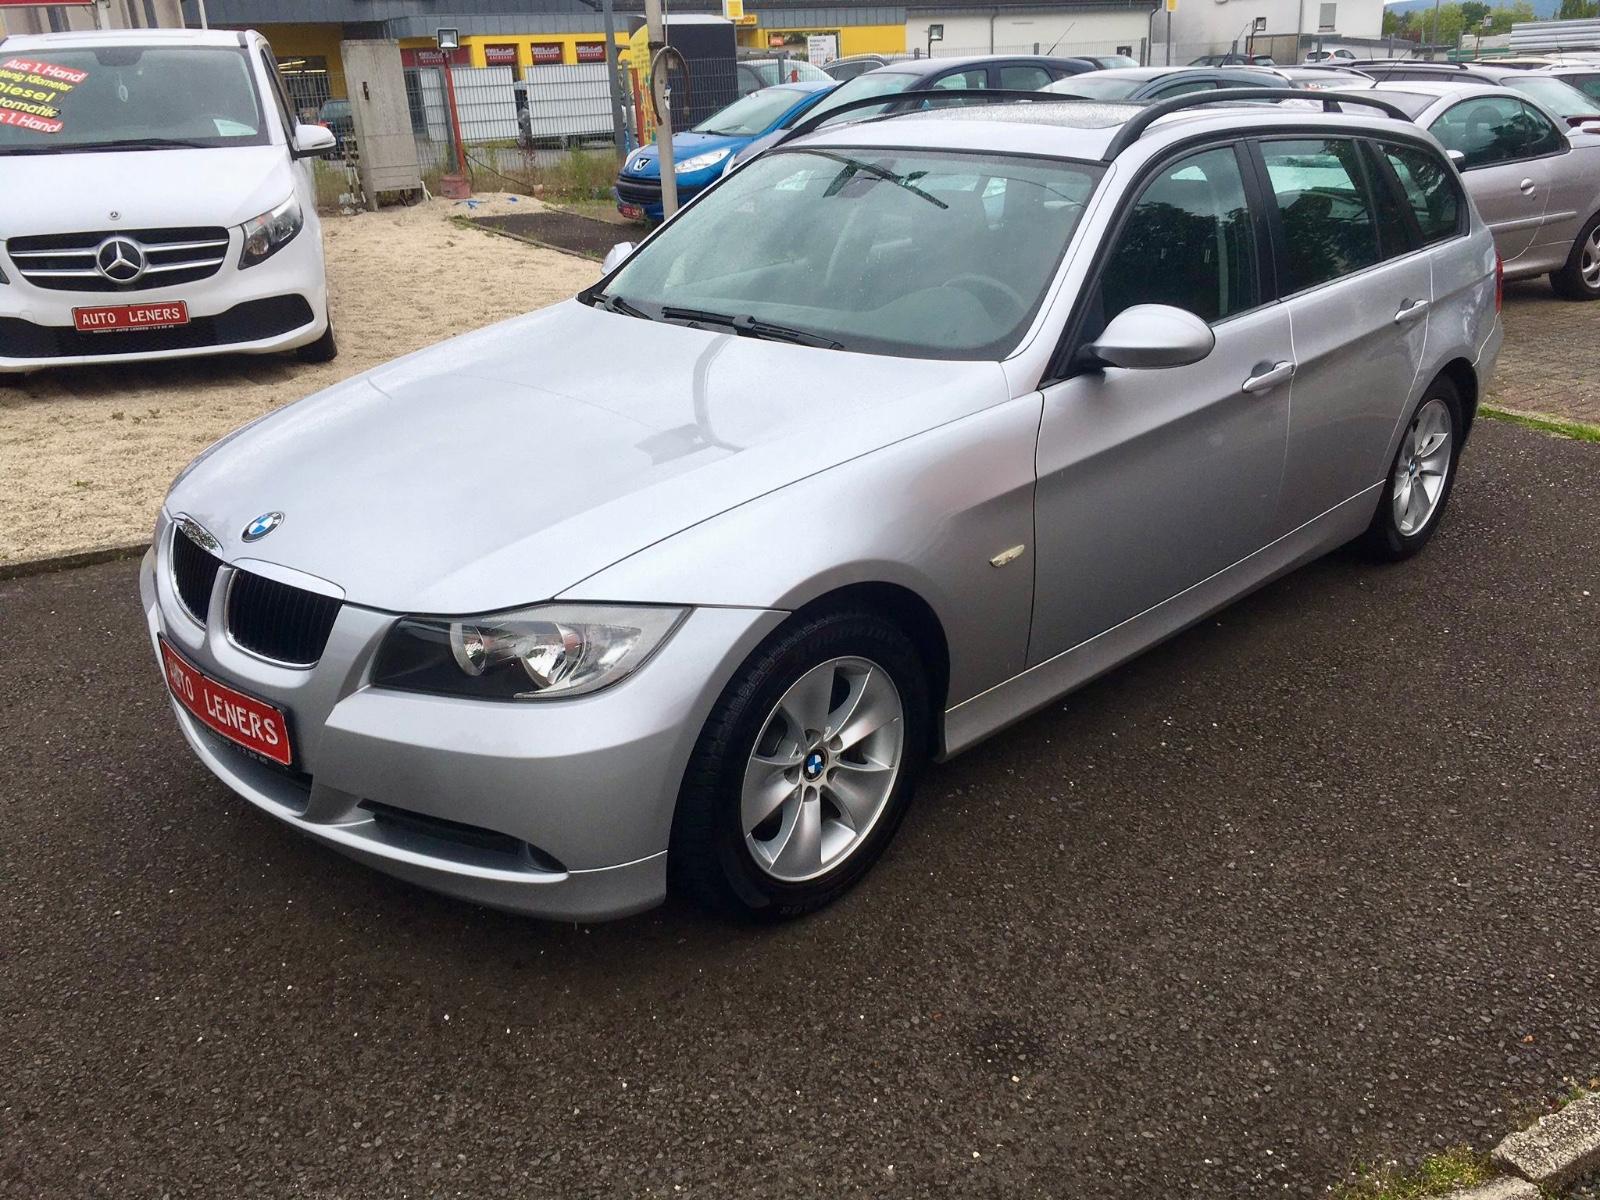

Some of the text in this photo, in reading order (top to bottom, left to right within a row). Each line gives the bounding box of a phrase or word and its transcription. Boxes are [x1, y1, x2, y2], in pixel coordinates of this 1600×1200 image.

[4, 59, 31, 71] Aus
[25, 74, 74, 92] Kilometer
[82, 308, 180, 326] AUTO LENERS
[203, 688, 279, 746] LENERS
